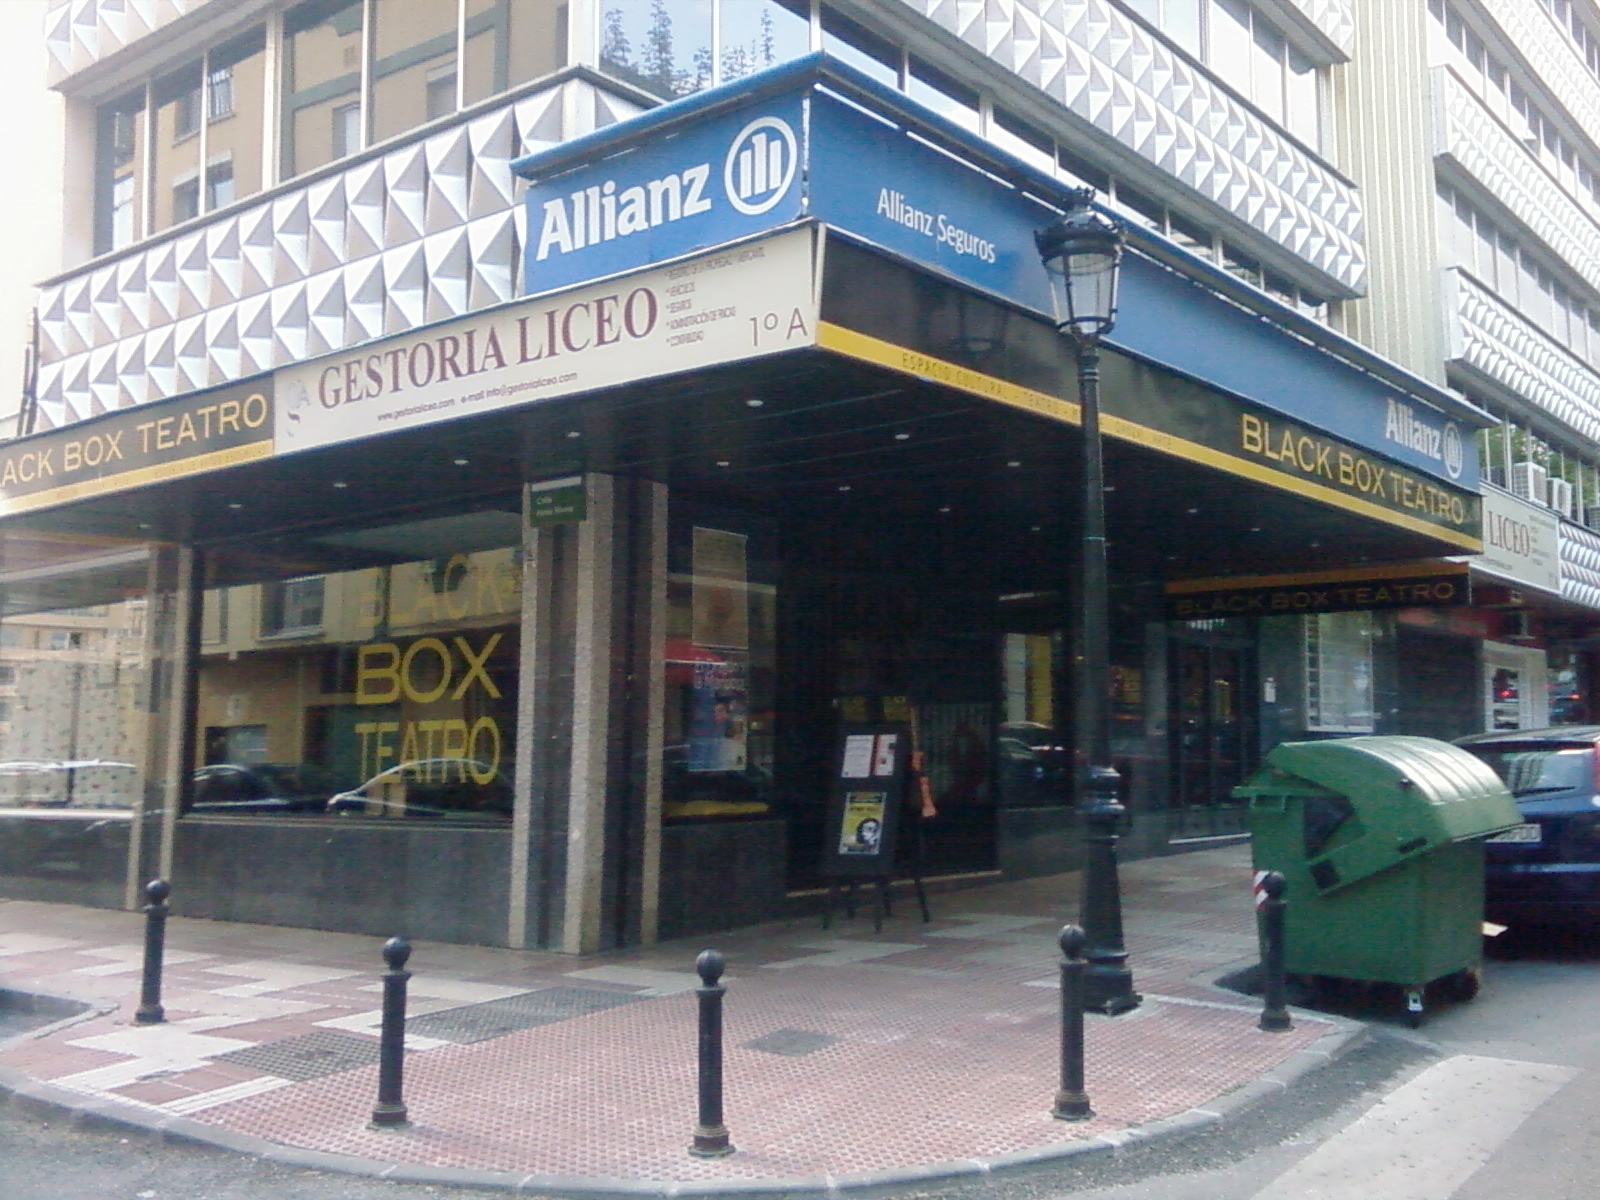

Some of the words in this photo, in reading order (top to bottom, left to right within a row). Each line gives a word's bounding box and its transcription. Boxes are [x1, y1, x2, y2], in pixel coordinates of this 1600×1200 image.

[536, 163, 712, 261] Allianz
[877, 188, 933, 236] Allianz
[937, 214, 996, 264] Seguros
[318, 325, 508, 410] GESTORIA
[516, 287, 659, 365] LICEO
[786, 307, 808, 340] A
[64, 430, 123, 472] BOX
[136, 393, 268, 453] TEATRO
[1385, 397, 1441, 460] Allianz
[1242, 413, 1333, 480] BLACK
[1339, 452, 1386, 498] BOX
[1390, 471, 1464, 525] TEATRO
[1488, 510, 1530, 558] LICEO
[1270, 590, 1329, 609] BOX
[1338, 582, 1455, 605] TEATRO
[357, 634, 503, 705] BOX
[355, 716, 500, 785] TEATRO
